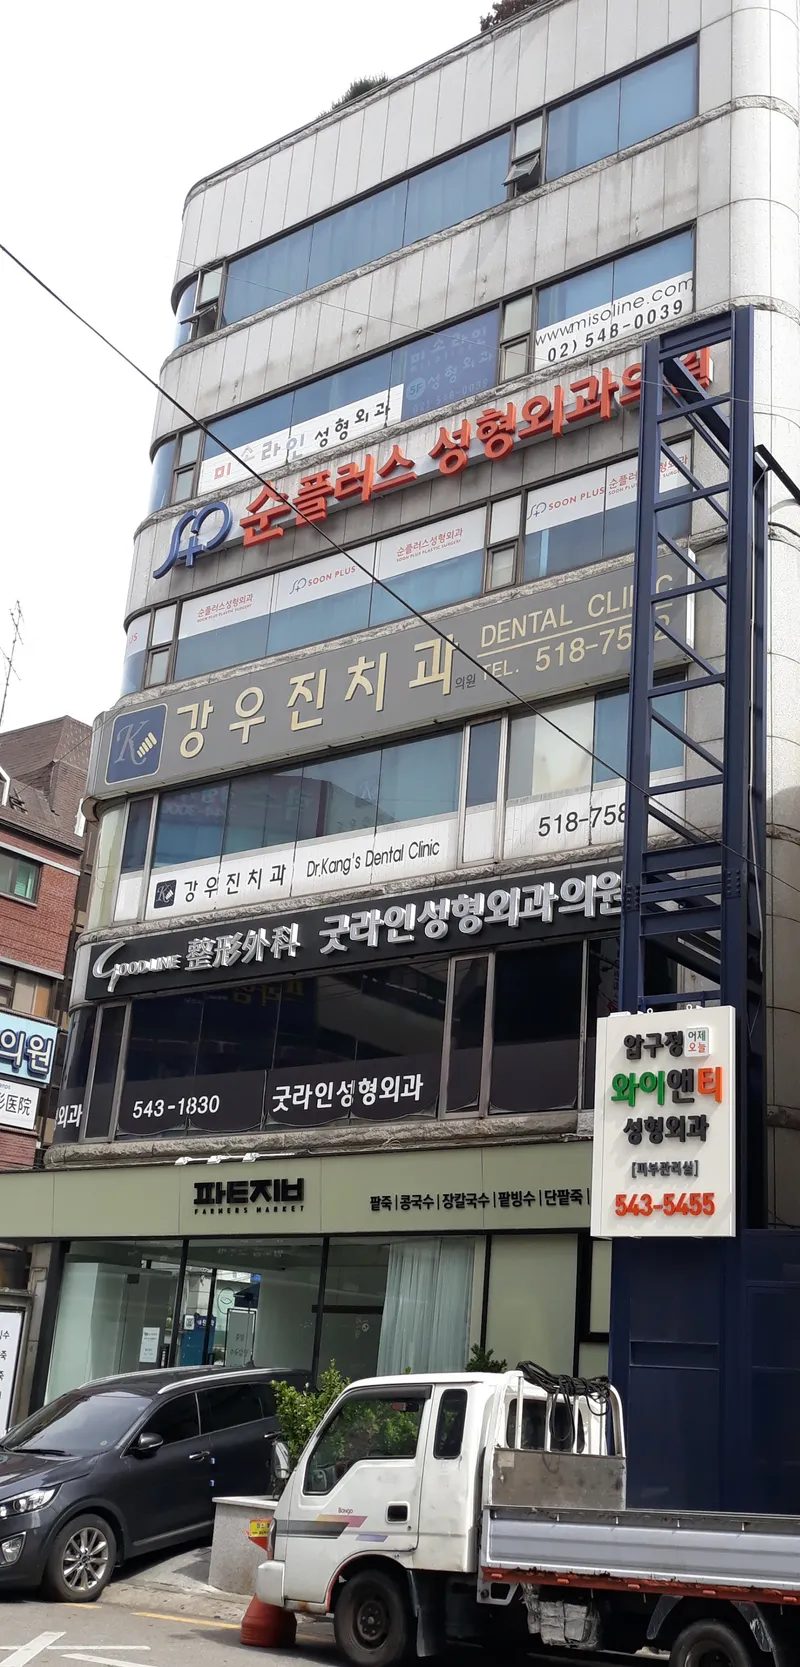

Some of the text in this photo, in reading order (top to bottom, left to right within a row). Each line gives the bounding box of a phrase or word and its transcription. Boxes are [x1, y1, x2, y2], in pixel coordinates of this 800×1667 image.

[548, 299, 683, 362] 02) 548-0039
[314, 402, 391, 448] 성형외과
[240, 444, 418, 549] 순플러스
[548, 486, 606, 511] SOON PLUS
[397, 528, 463, 557] 순플러스성형외과
[308, 566, 356, 587] SOON PLUS
[481, 574, 674, 649] DENTAL CLIC
[482, 614, 671, 681] TEL. 518-752
[177, 634, 476, 759] 강우진치과 의원
[306, 838, 440, 879] Dr.Kang's Dental Clinic
[184, 865, 287, 903] 강우진치과
[319, 870, 623, 954] 굿라인성형외과의원
[185, 922, 301, 971] 整形外科
[623, 1030, 684, 1060] 압구정
[688, 1030, 706, 1042] 어제
[688, 1042, 706, 1053] 오늘
[272, 1073, 424, 1112] 굿라인성형외과
[611, 1066, 722, 1107] 와이앤티
[132, 1094, 220, 1119] 543-1830
[623, 1114, 709, 1145] 성형외과
[194, 1205, 304, 1215] FARMERS MARKET
[615, 1192, 716, 1217] 543-5455
